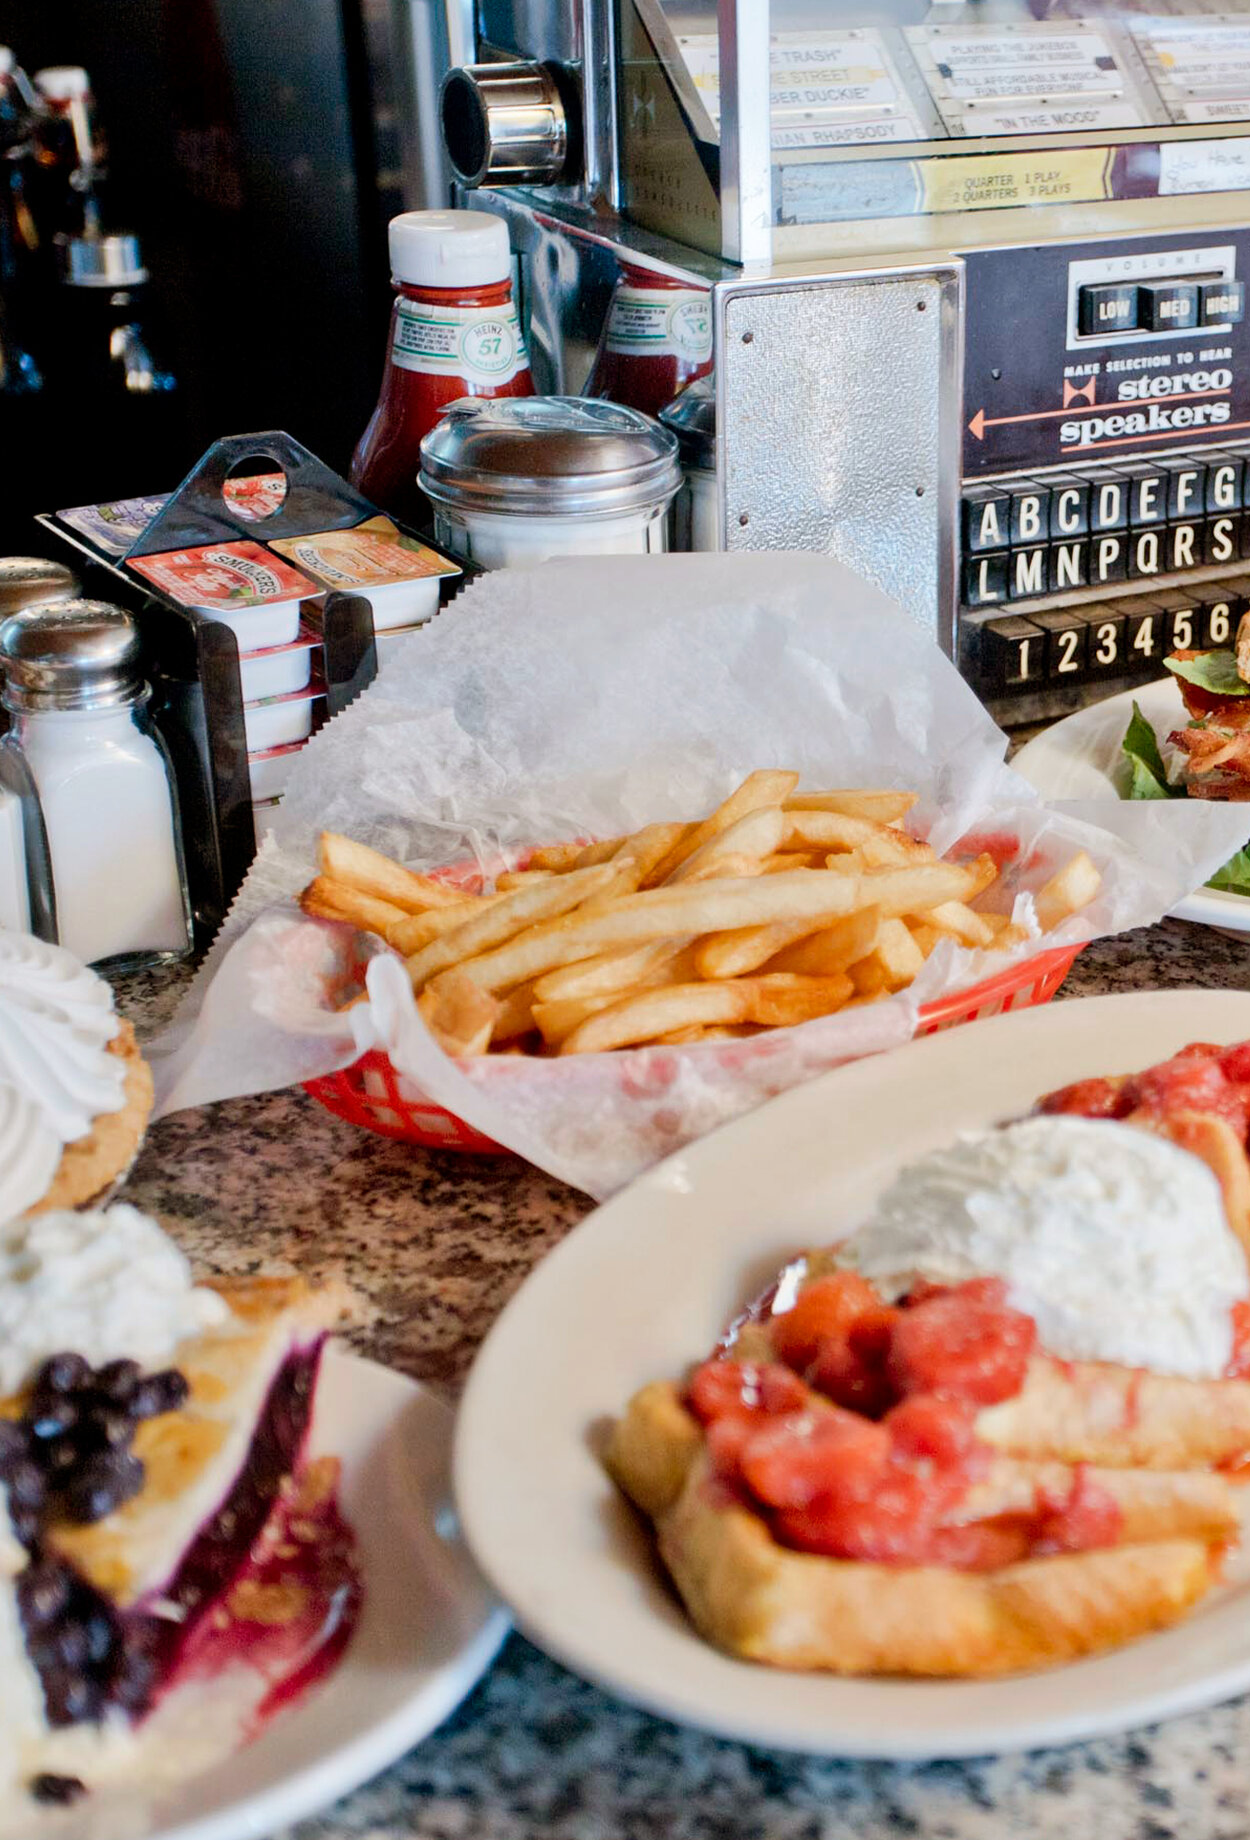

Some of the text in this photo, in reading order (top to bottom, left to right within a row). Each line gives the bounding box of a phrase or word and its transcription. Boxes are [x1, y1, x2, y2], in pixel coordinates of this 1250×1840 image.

[789, 68, 850, 84] STREET
[1018, 114, 1050, 128] THE
[811, 123, 897, 144] RHAPSODY
[964, 174, 1014, 189] QUARTER
[1034, 171, 1062, 184] PLAY
[962, 187, 1019, 204] QUARTERS
[1038, 183, 1072, 196] PLAYS
[1105, 254, 1204, 273] VOLUME
[1099, 297, 1131, 321] LOW
[1159, 297, 1191, 320] MED
[1205, 294, 1240, 315] HIGH
[474, 324, 504, 339] HEINZ
[480, 337, 502, 356] 57
[1064, 347, 1233, 378] MAKE SELECTION TO HEAR
[1117, 366, 1233, 402] stereo
[1060, 400, 1232, 446] speakers
[980, 504, 1001, 545] A
[1020, 497, 1040, 539] B
[1059, 491, 1081, 533] C
[1100, 485, 1120, 526] D
[1140, 479, 1158, 521] E
[1178, 473, 1196, 513] F
[1215, 467, 1234, 507] G
[980, 561, 998, 600] L
[1017, 551, 1041, 593] M
[1058, 545, 1079, 586] N
[1100, 539, 1119, 580] P
[1138, 534, 1157, 572] Q
[1175, 527, 1193, 566] R
[1213, 520, 1232, 560] S
[1020, 641, 1028, 678] 1
[1059, 632, 1077, 672] 2
[1097, 624, 1116, 663] 3
[1135, 618, 1153, 655] 4
[1174, 611, 1191, 649] 5
[1211, 605, 1228, 641] 6
